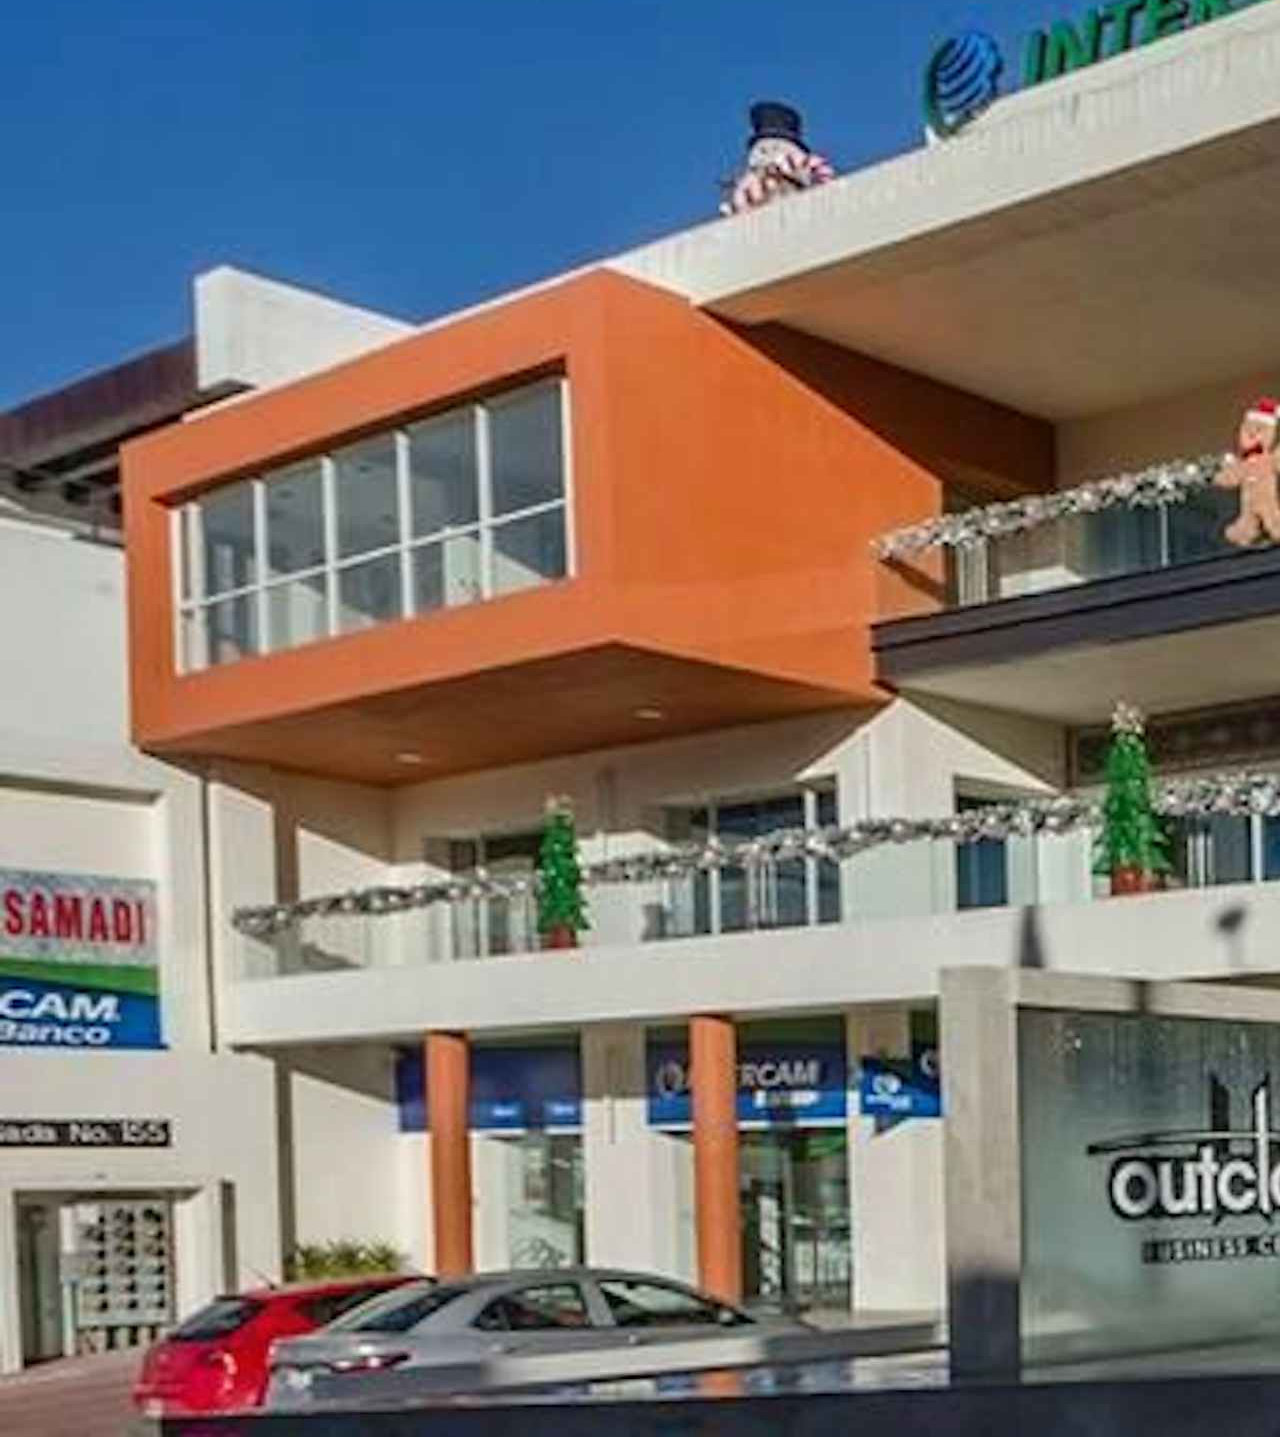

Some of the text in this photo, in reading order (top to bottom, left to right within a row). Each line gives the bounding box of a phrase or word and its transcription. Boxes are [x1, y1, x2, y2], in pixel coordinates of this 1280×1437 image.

[4, 888, 146, 945] SAMADI
[0, 988, 121, 1022] CAM
[0, 1122, 58, 1143] ada
[121, 1120, 168, 1143] 155
